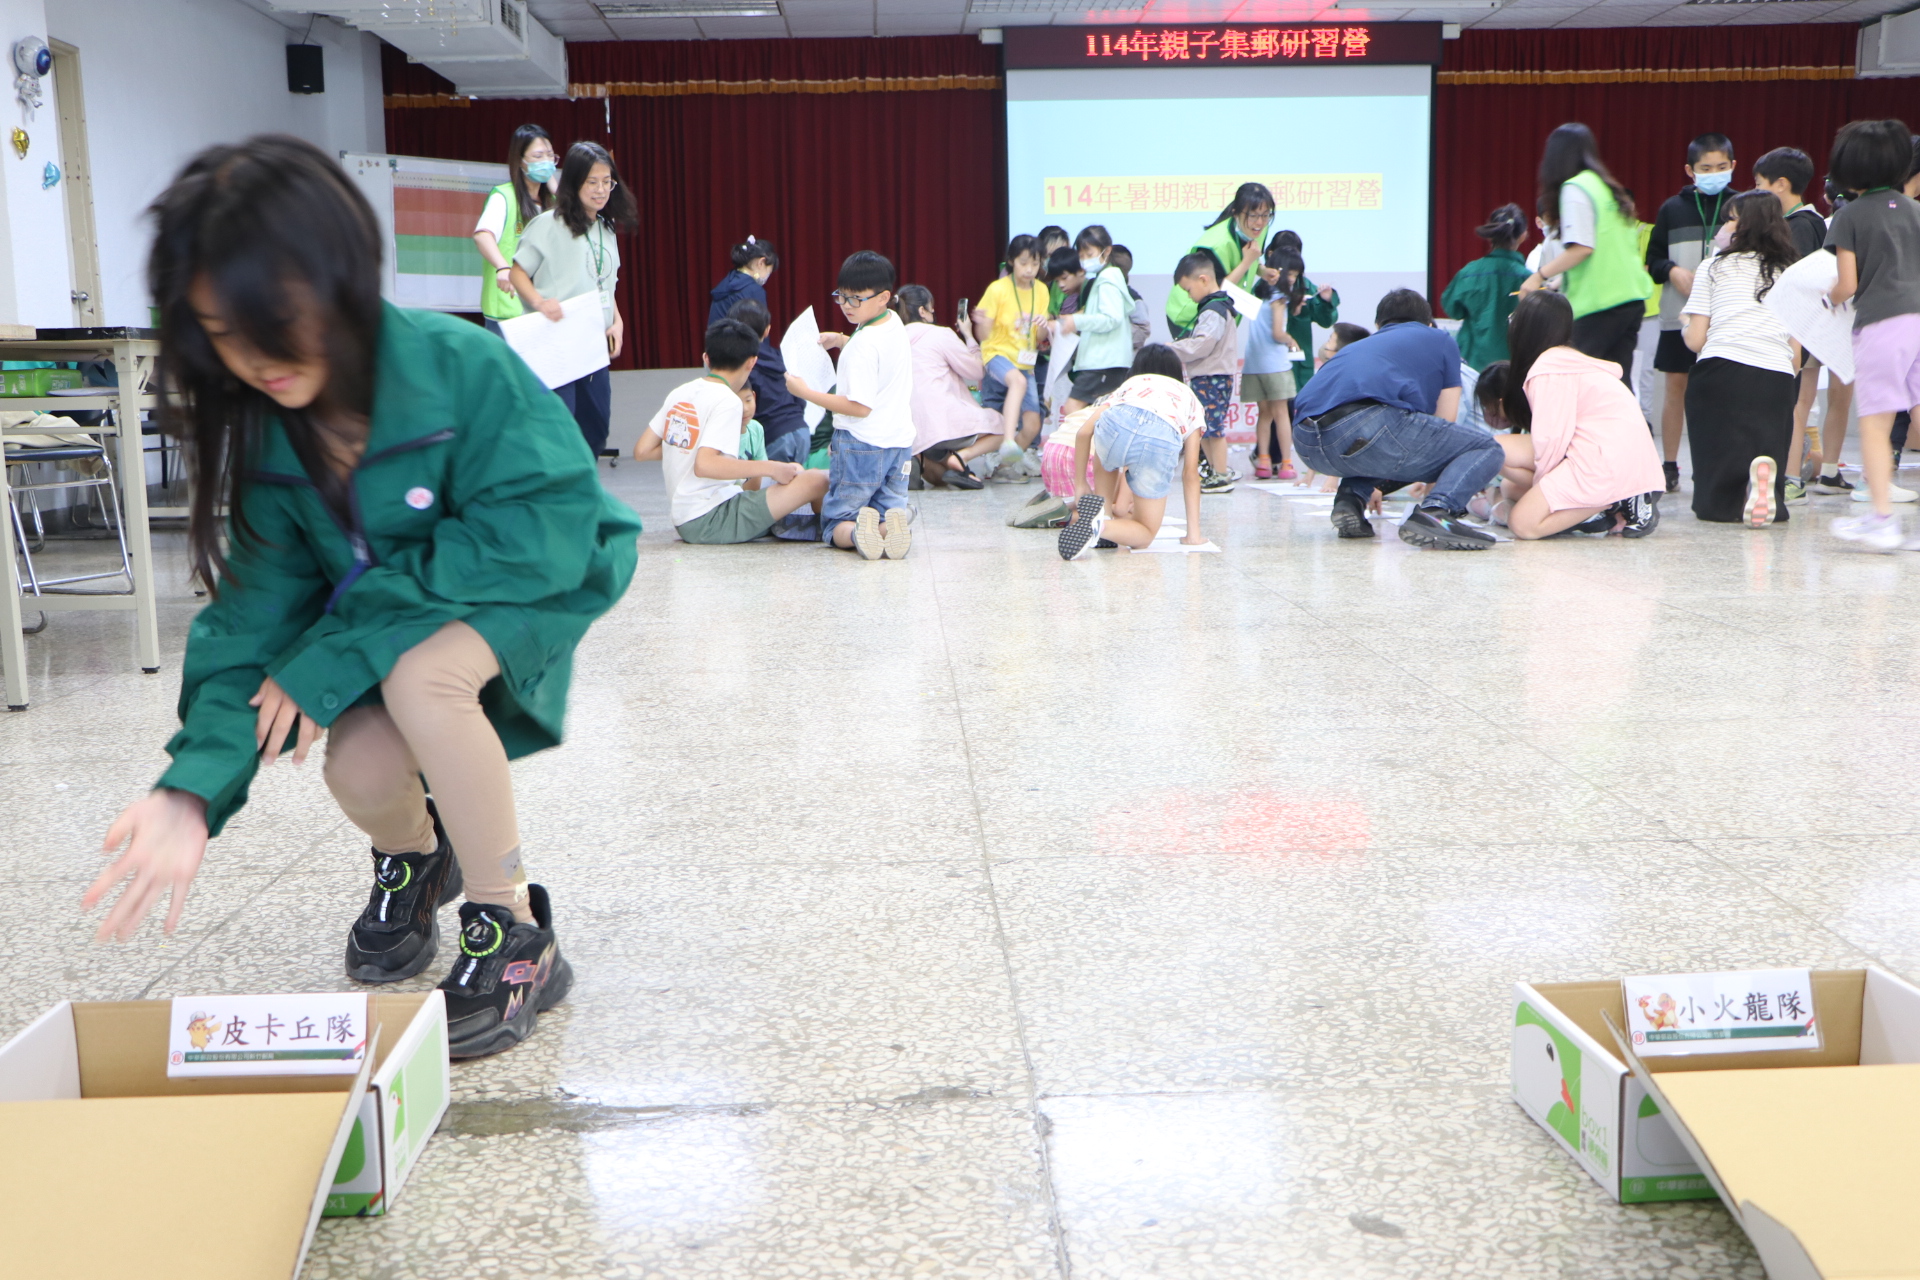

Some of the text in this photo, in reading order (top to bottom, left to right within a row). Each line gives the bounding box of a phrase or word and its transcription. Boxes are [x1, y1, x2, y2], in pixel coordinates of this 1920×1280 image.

[1086, 28, 1371, 61] 114年親子集郵研習營
[1046, 179, 1382, 212] 114年暑期親子郵研習營
[1679, 990, 1807, 1024] 小火龍隊
[221, 1012, 357, 1047] 皮卡丘隊
